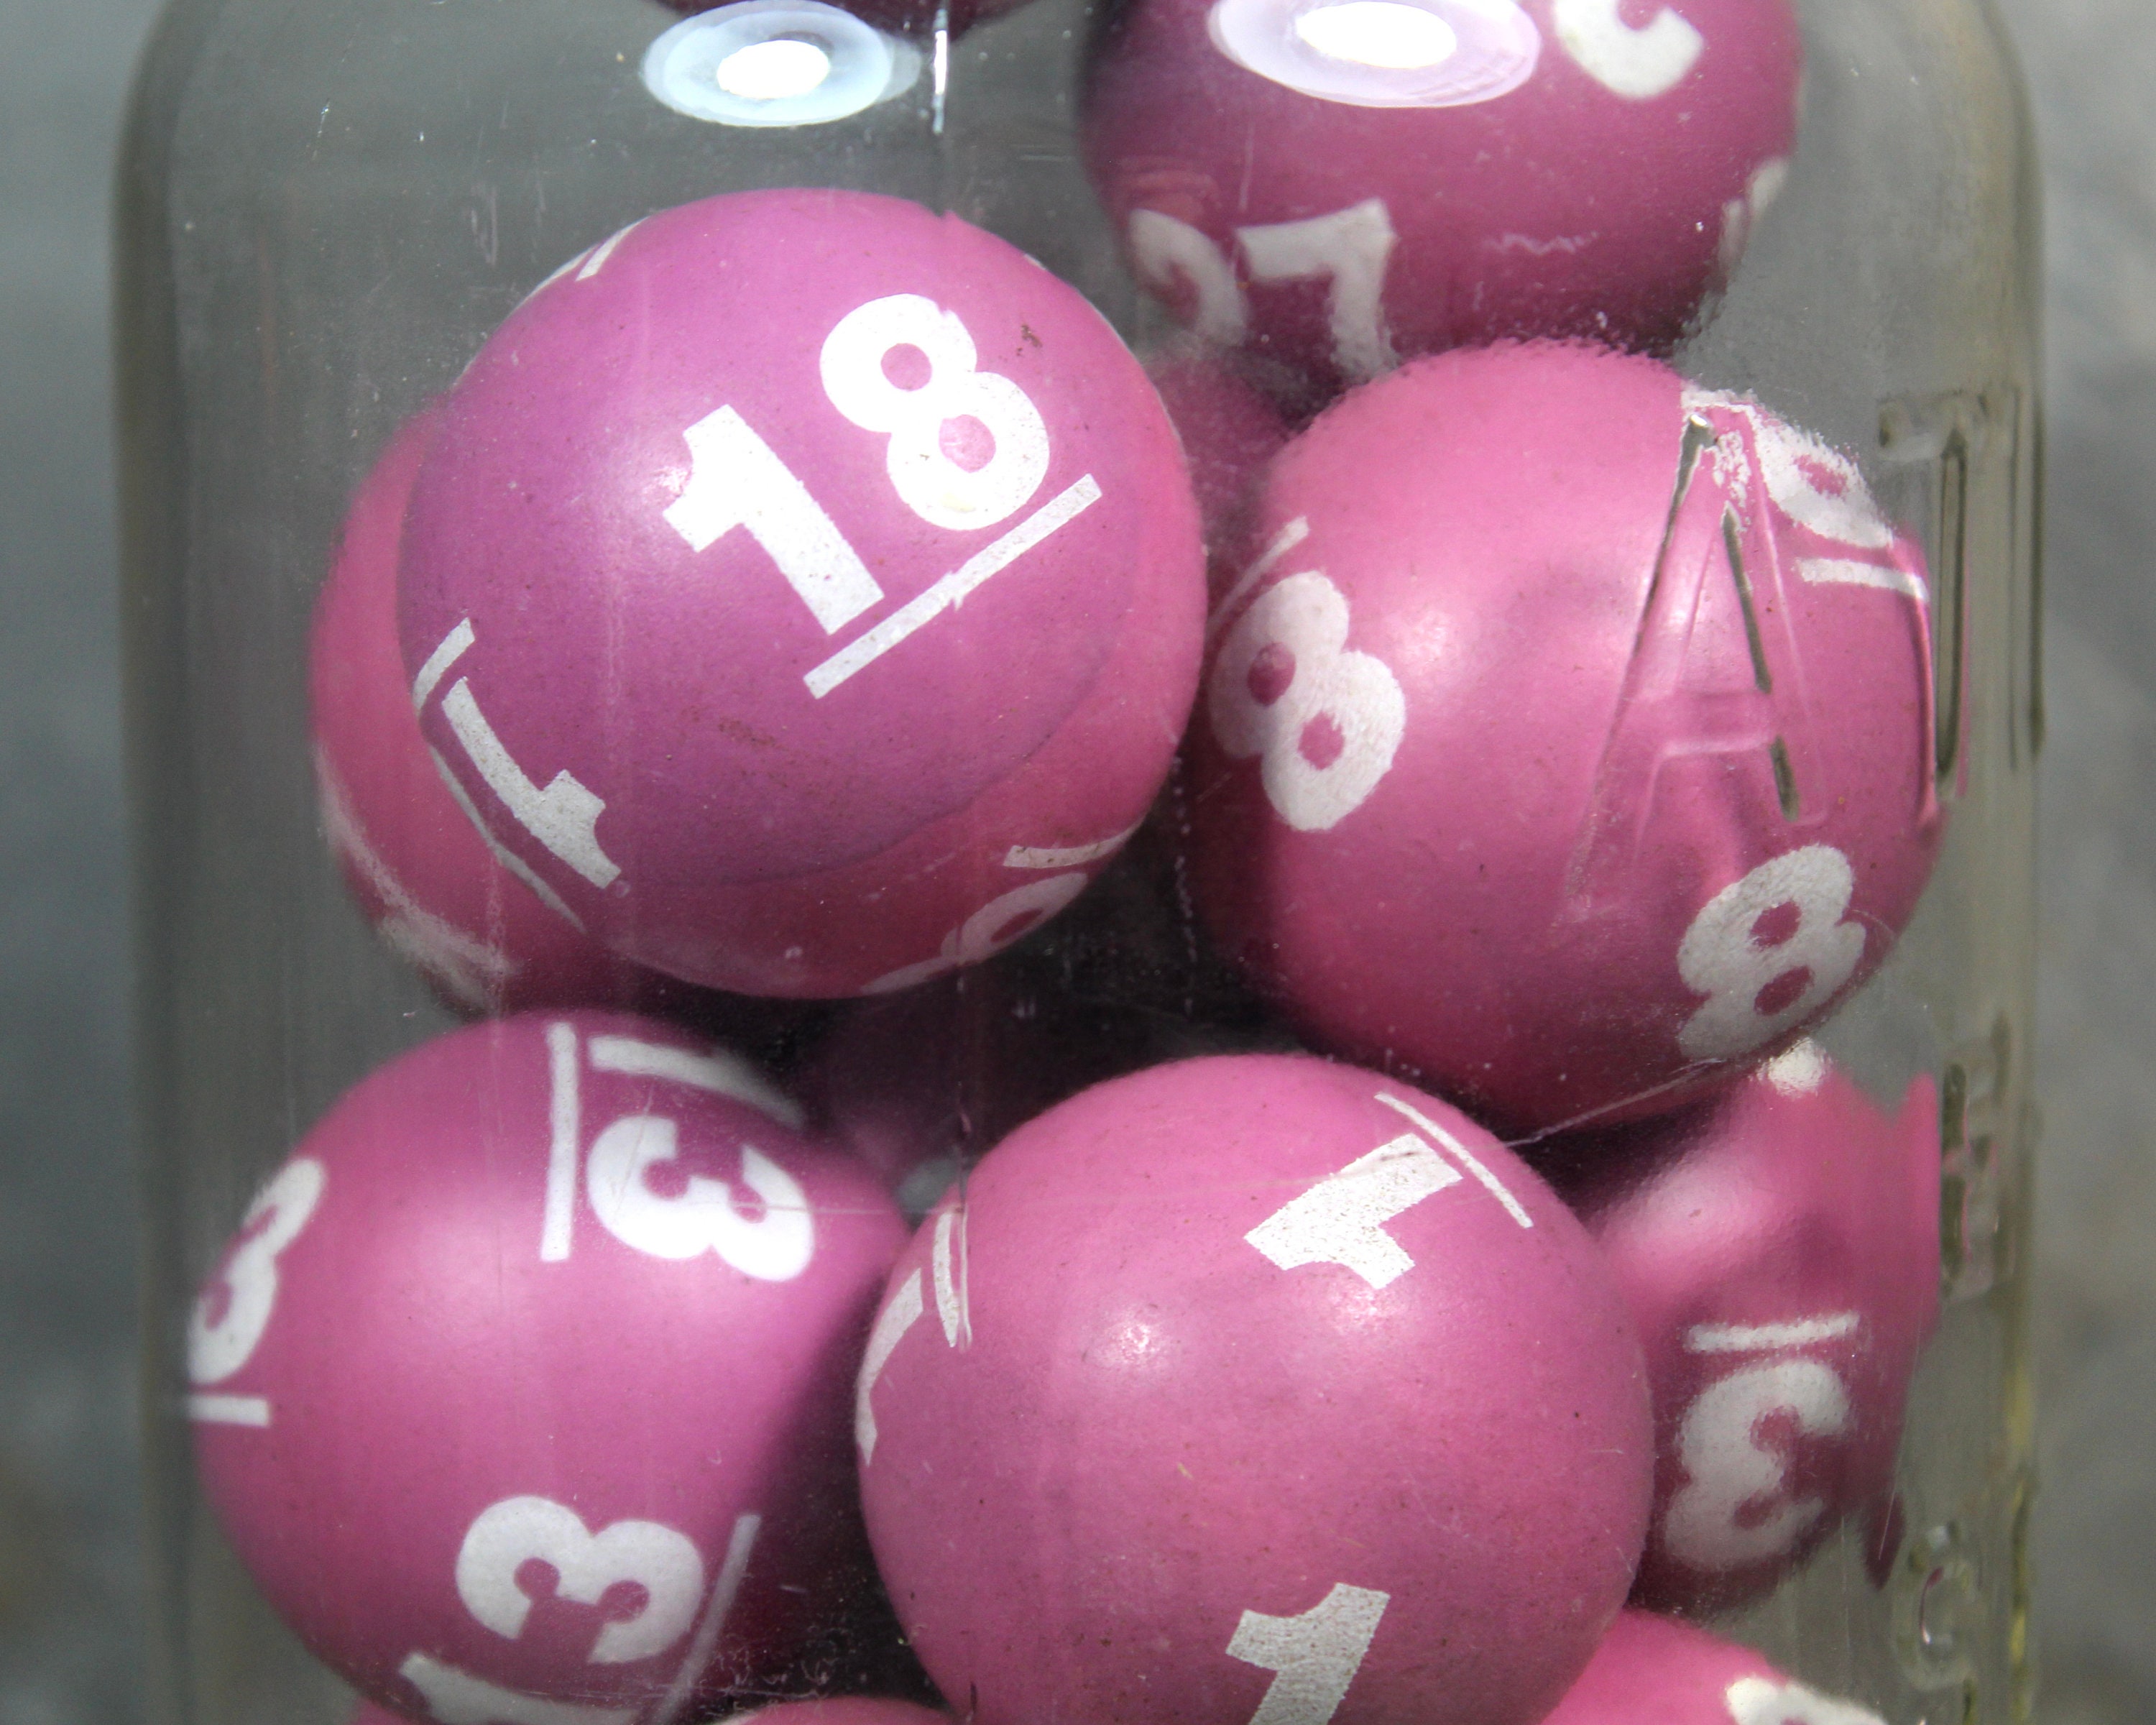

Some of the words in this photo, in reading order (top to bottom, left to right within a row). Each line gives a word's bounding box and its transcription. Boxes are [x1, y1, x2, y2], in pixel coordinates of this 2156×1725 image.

[662, 293, 1050, 635] 18
[1210, 571, 1406, 831] 8
[1677, 845, 1866, 1061] 8
[1243, 1132, 1463, 1291] 1
[1664, 1358, 1853, 1573] 3
